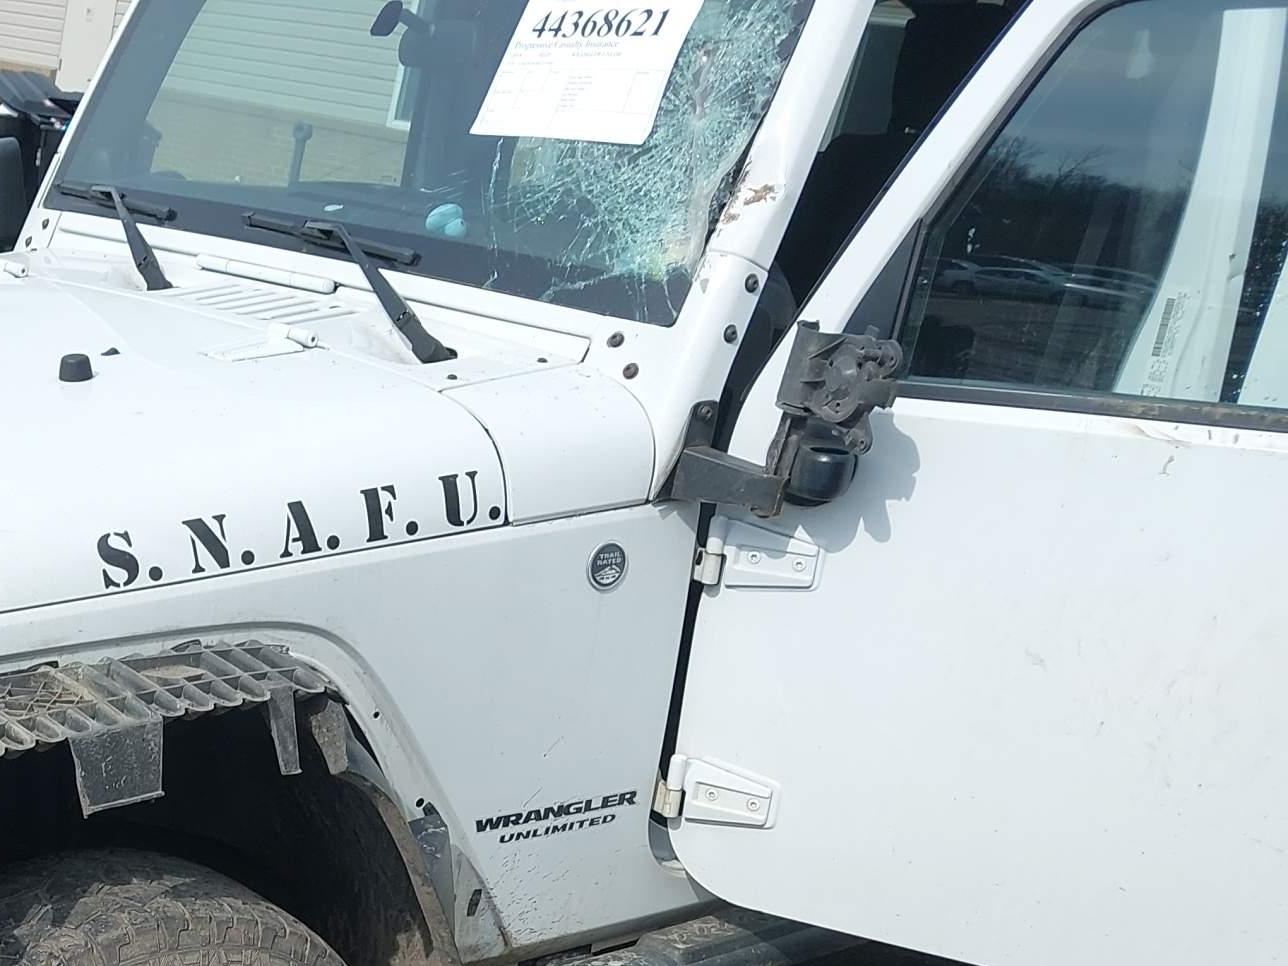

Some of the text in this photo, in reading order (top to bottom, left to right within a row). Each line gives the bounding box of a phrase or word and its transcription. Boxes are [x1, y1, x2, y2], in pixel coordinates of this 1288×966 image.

[532, 8, 670, 38] 44368621
[598, 551, 622, 560] TRAIL
[475, 790, 637, 833] WRANGLER
[499, 814, 616, 844] UNLIMITED
